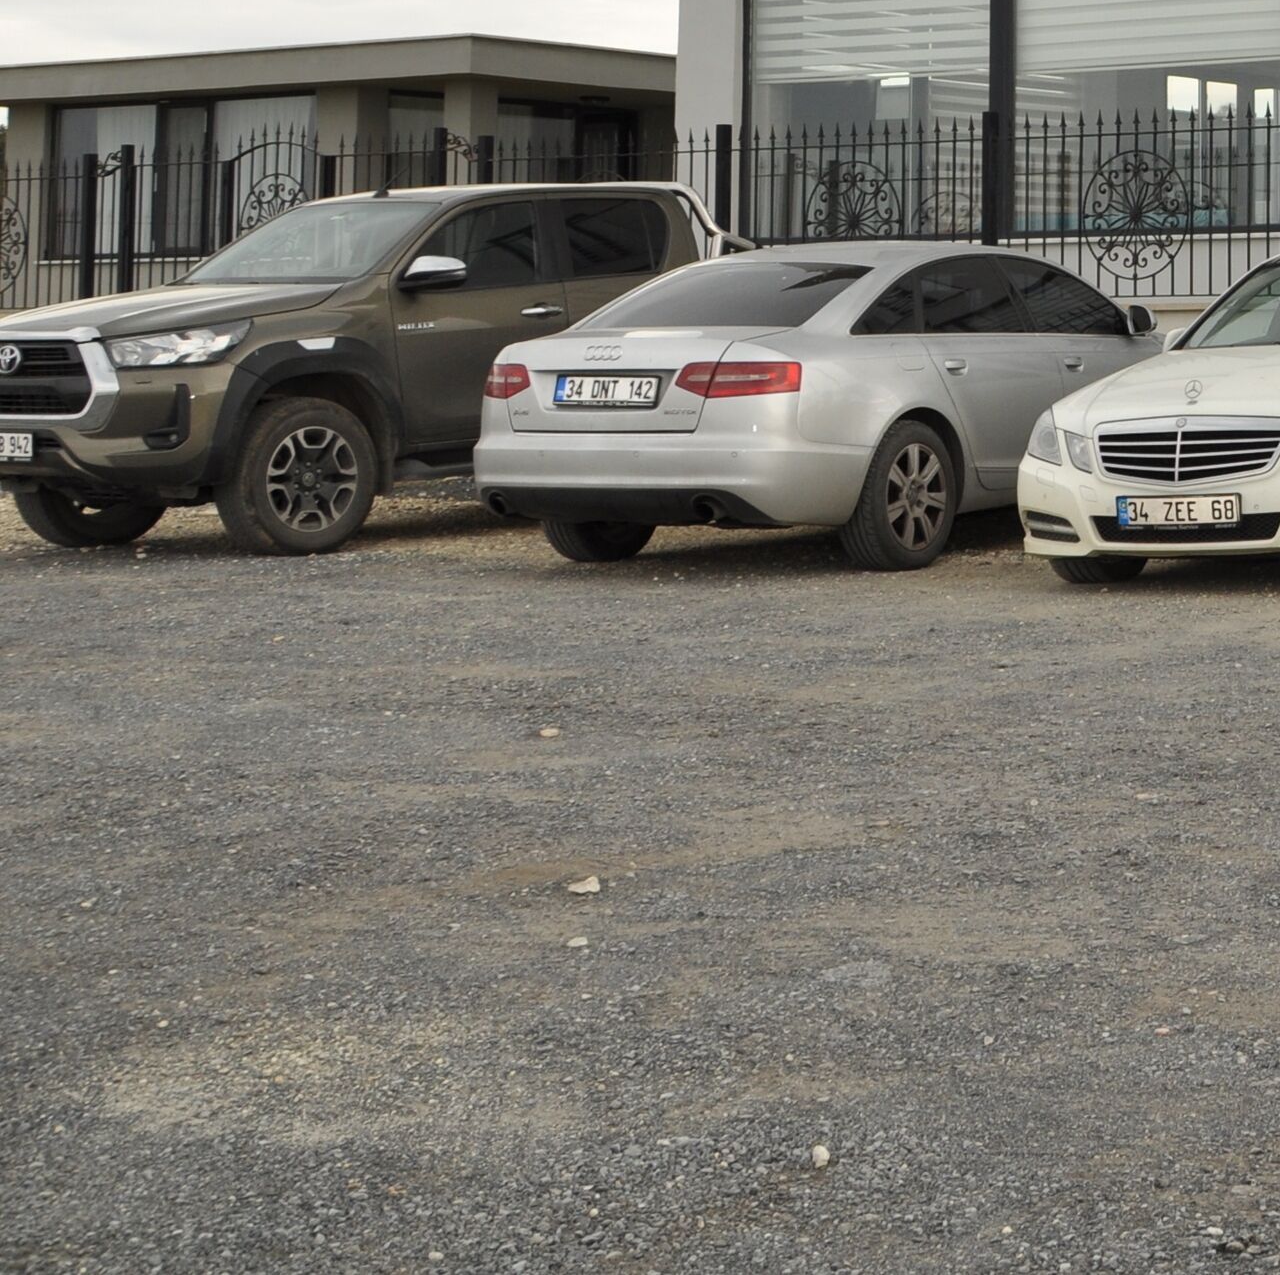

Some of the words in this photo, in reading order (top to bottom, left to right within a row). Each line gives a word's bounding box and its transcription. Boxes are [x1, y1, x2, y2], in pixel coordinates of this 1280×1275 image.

[566, 379, 584, 399] 34
[591, 379, 619, 399] DNT
[629, 380, 653, 400] 142
[10, 436, 29, 454] 942
[1128, 501, 1149, 522] 34
[1163, 501, 1198, 522] ZEE
[1211, 499, 1235, 520] 68
